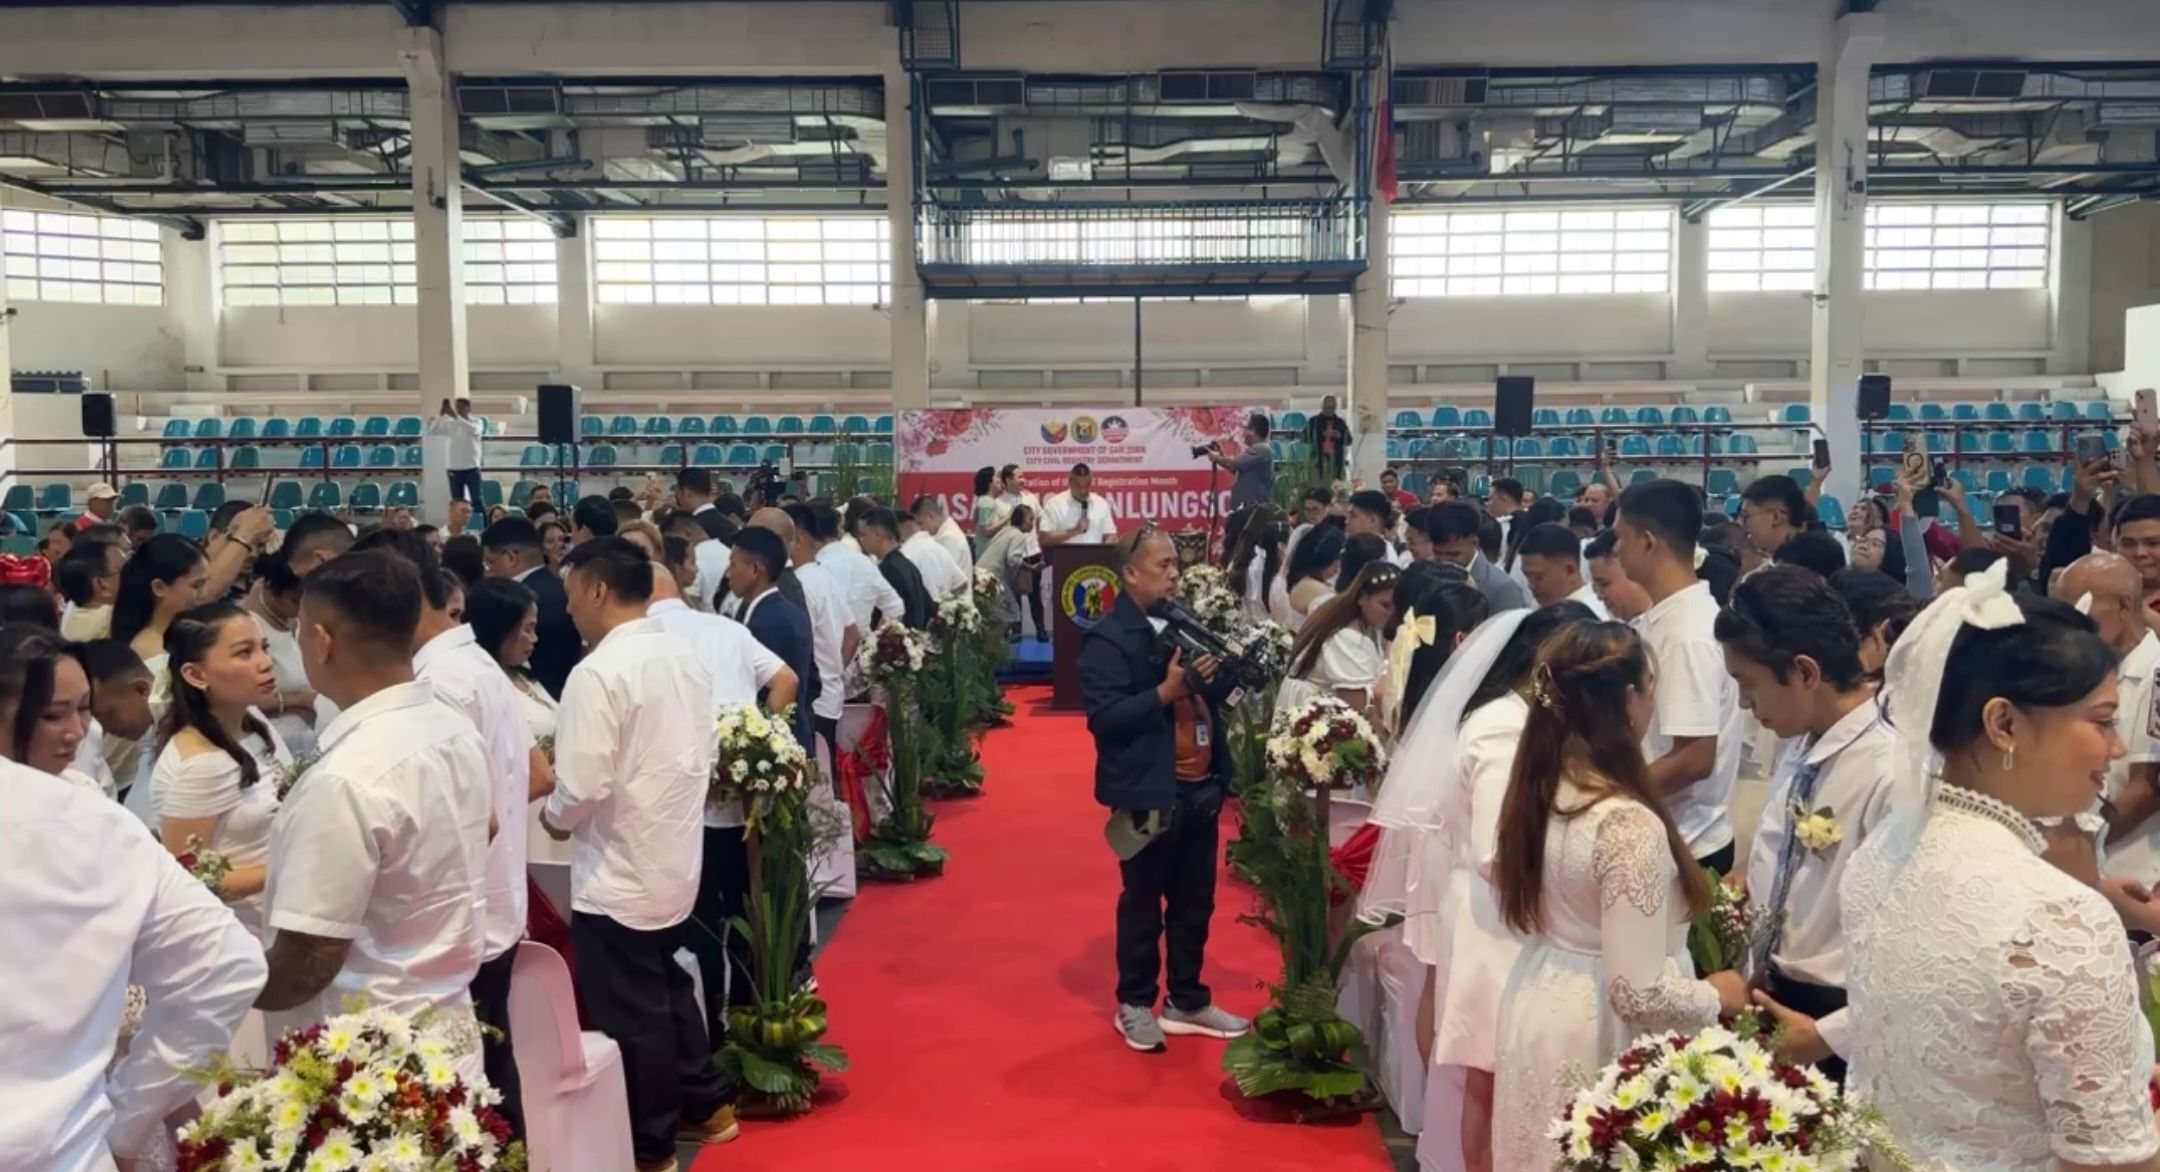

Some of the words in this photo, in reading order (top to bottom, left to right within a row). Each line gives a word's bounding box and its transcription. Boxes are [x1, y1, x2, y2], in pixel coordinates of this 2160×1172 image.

[1023, 446, 1041, 455] CITY
[1042, 446, 1096, 455] GOVERNMENT
[1097, 446, 1107, 454] OF
[1025, 457, 1042, 465] CITY
[1097, 456, 1144, 464] DEPARTMENT
[1023, 478, 1050, 487] ration
[1051, 478, 1061, 487] of
[1097, 477, 1149, 488] Registration
[1150, 477, 1178, 486] Month
[1105, 491, 1233, 519] NLUNGSO
